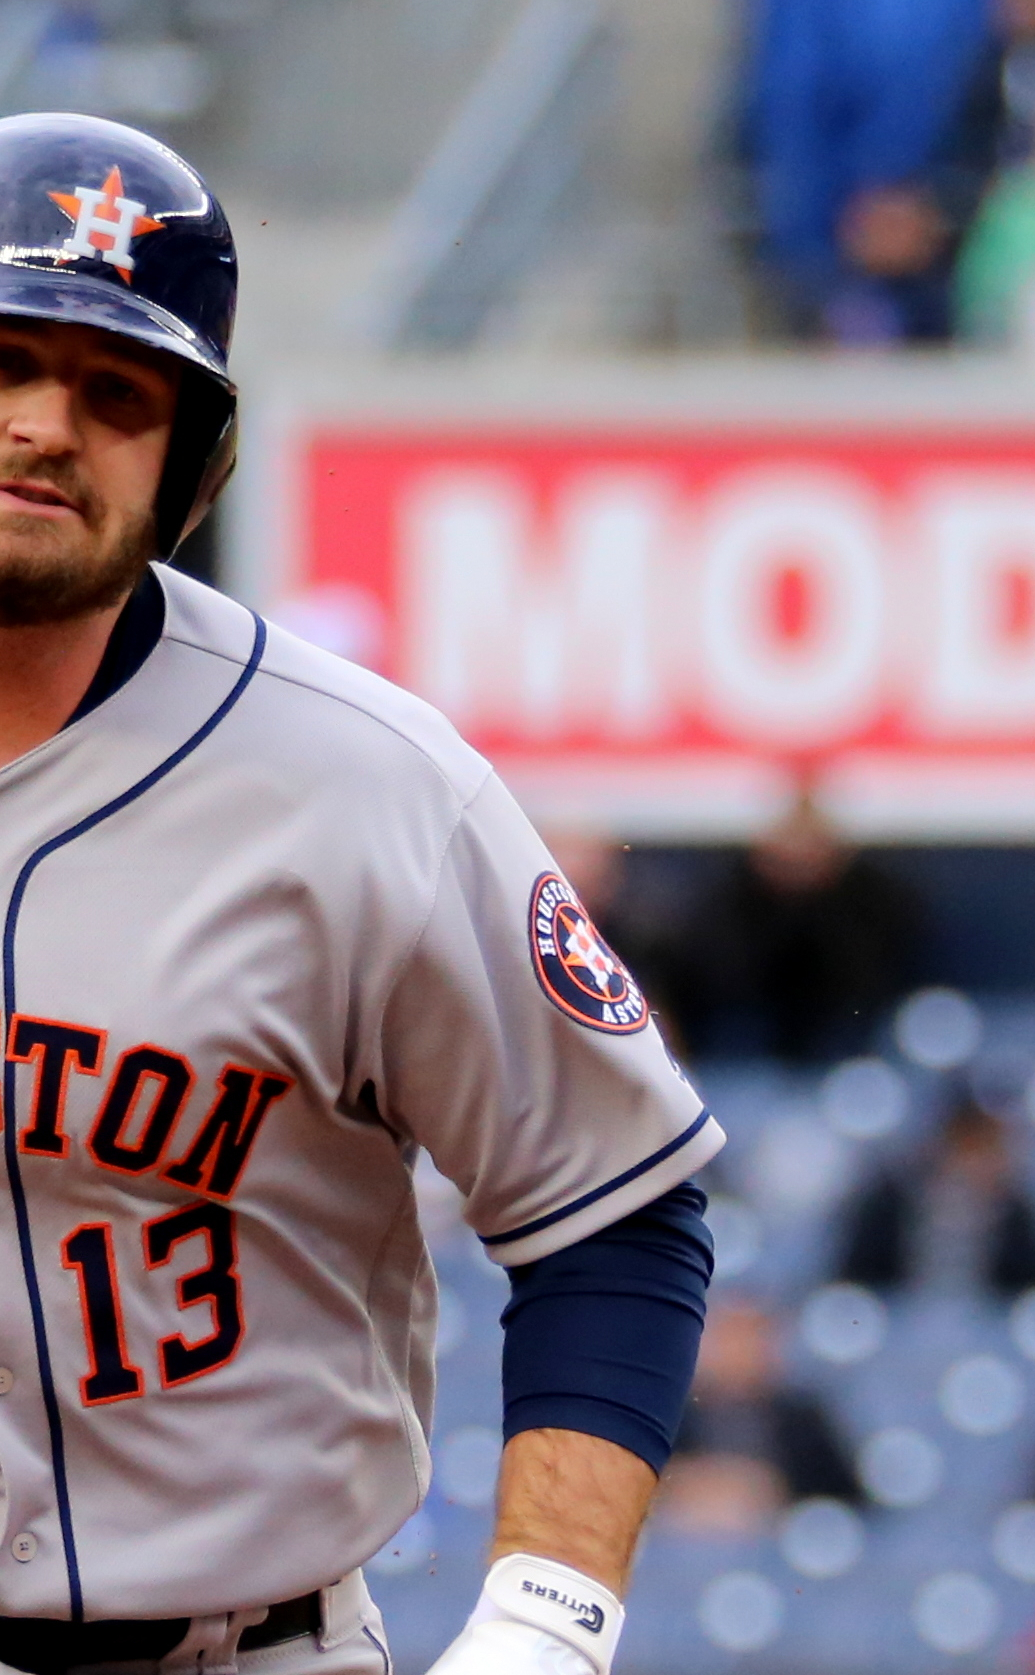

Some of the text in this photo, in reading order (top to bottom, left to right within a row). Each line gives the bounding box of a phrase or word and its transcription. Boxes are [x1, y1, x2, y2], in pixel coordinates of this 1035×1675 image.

[73, 186, 147, 270] H
[60, 1200, 245, 1406] 13
[521, 1579, 605, 1634] CUTTERS
